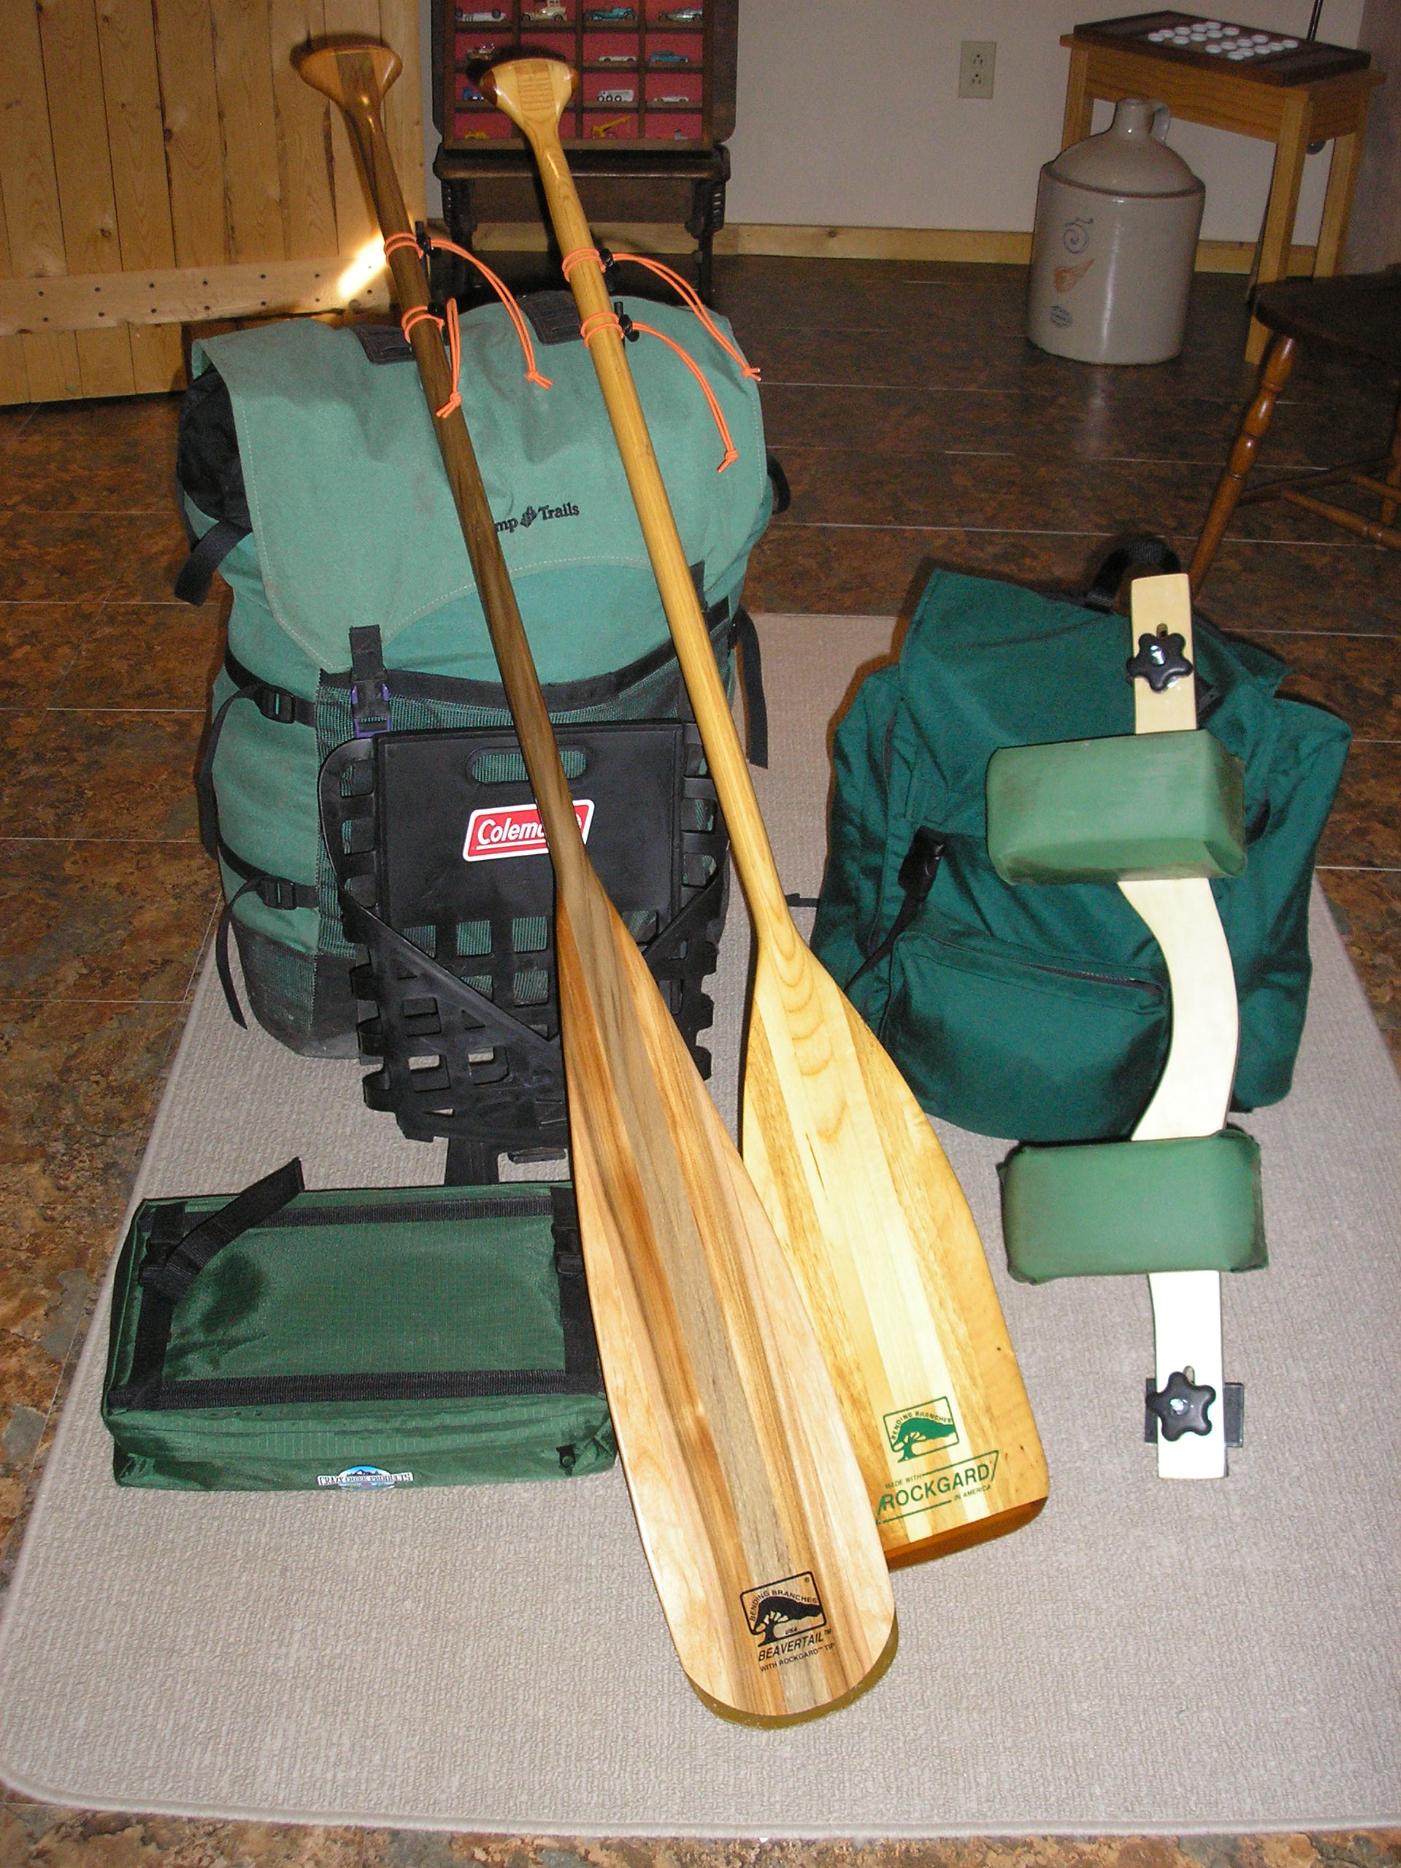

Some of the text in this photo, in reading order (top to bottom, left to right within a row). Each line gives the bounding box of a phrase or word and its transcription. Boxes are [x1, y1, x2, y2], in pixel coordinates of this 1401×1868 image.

[495, 502, 580, 533] mp Trails
[477, 815, 582, 845] Colema
[890, 1410, 953, 1440] BENDING BRANCHES
[880, 1464, 991, 1511] ROCKGARD
[884, 1474, 922, 1489] MADE WITH
[963, 1484, 991, 1498] AMERICA
[749, 1589, 818, 1622] BENDING BRANCHES
[758, 1634, 824, 1662] BEAVERTAIL
[760, 1662, 778, 1672] WITH
[779, 1649, 819, 1666] ROCKGARD
